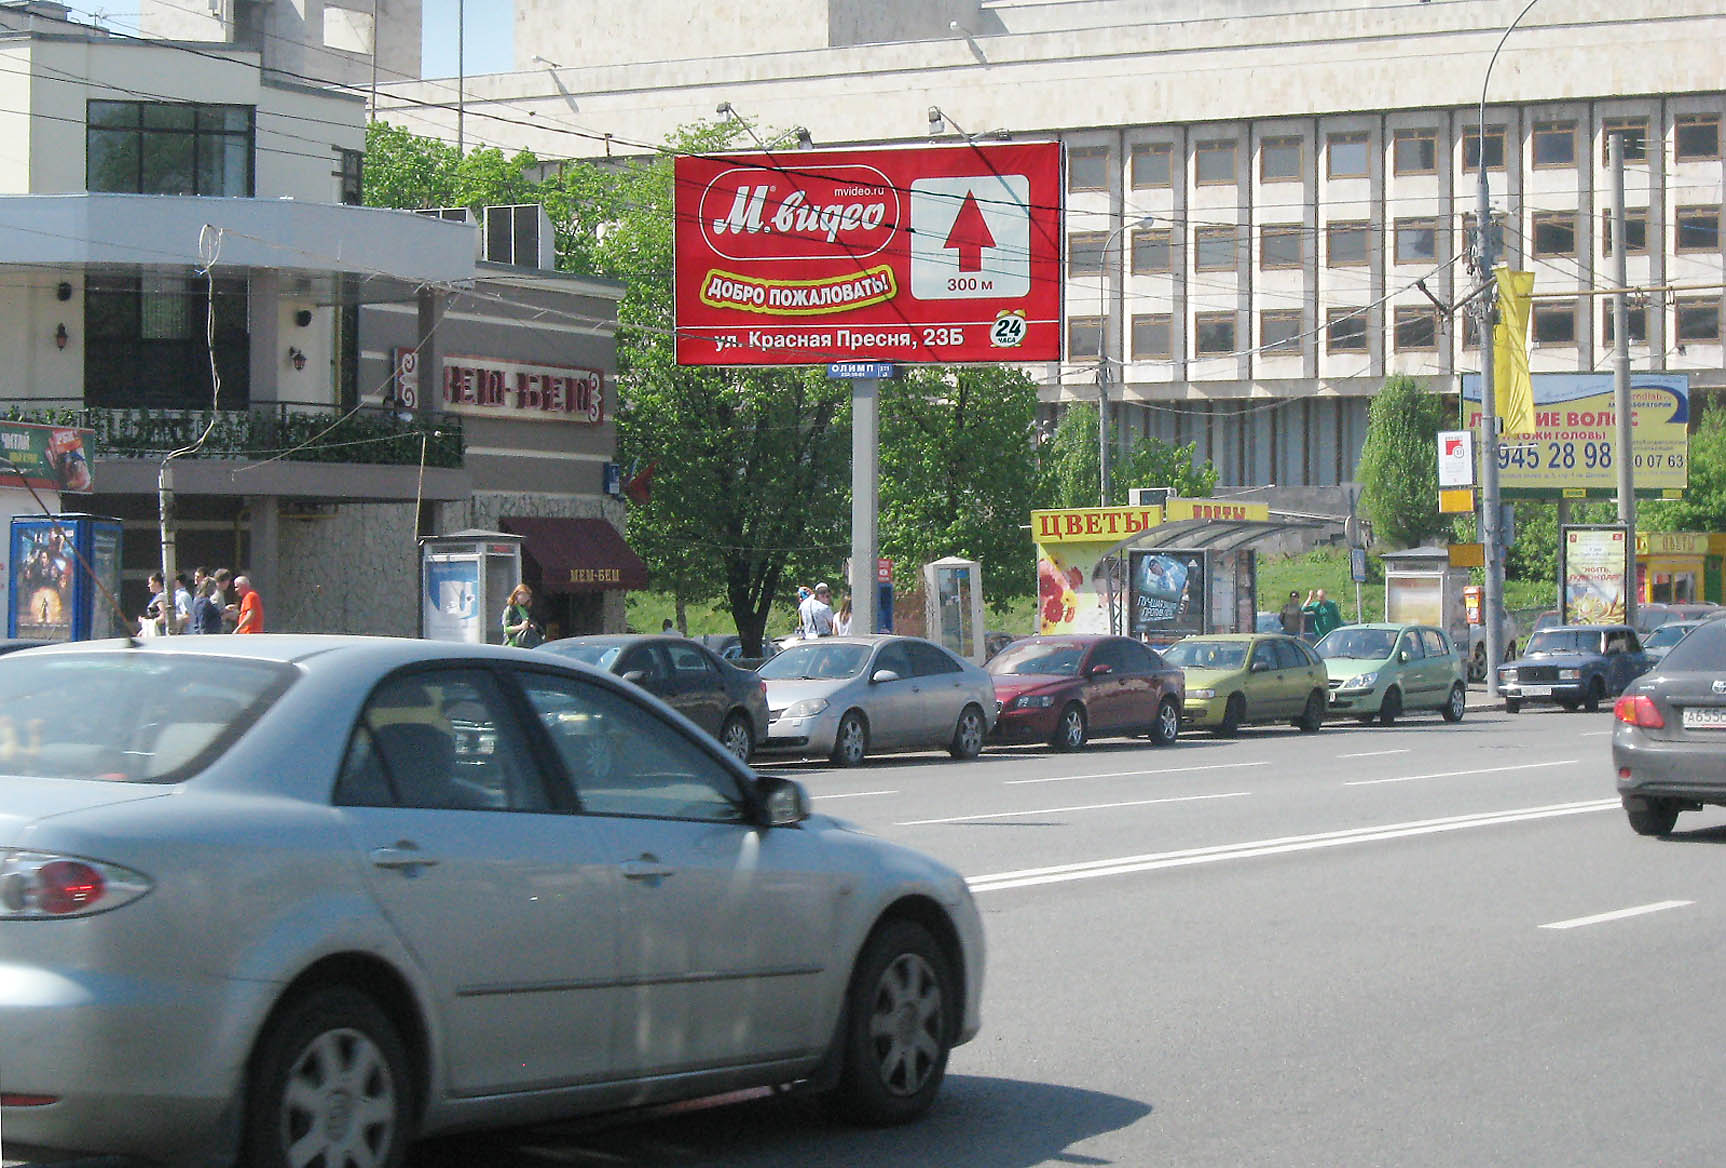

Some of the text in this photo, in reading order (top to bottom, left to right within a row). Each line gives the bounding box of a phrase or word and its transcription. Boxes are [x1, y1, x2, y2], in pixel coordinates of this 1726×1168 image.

[834, 186, 885, 197] mvideo.ru
[707, 273, 890, 307] ДОБРО ПОЖАЛОВАТЬ!
[947, 278, 993, 291] 300 м
[995, 319, 1022, 337] 24
[714, 328, 965, 352] ул. Красная Пресня, 23Б
[831, 364, 874, 373] ОЛИМП
[1555, 432, 1607, 441] ГОЛОВЫ
[1498, 442, 1612, 470] 945 28 98
[1647, 455, 1664, 468] 07
[1668, 455, 1684, 468] 63
[1040, 511, 1152, 540] ЦВЕТЫ
